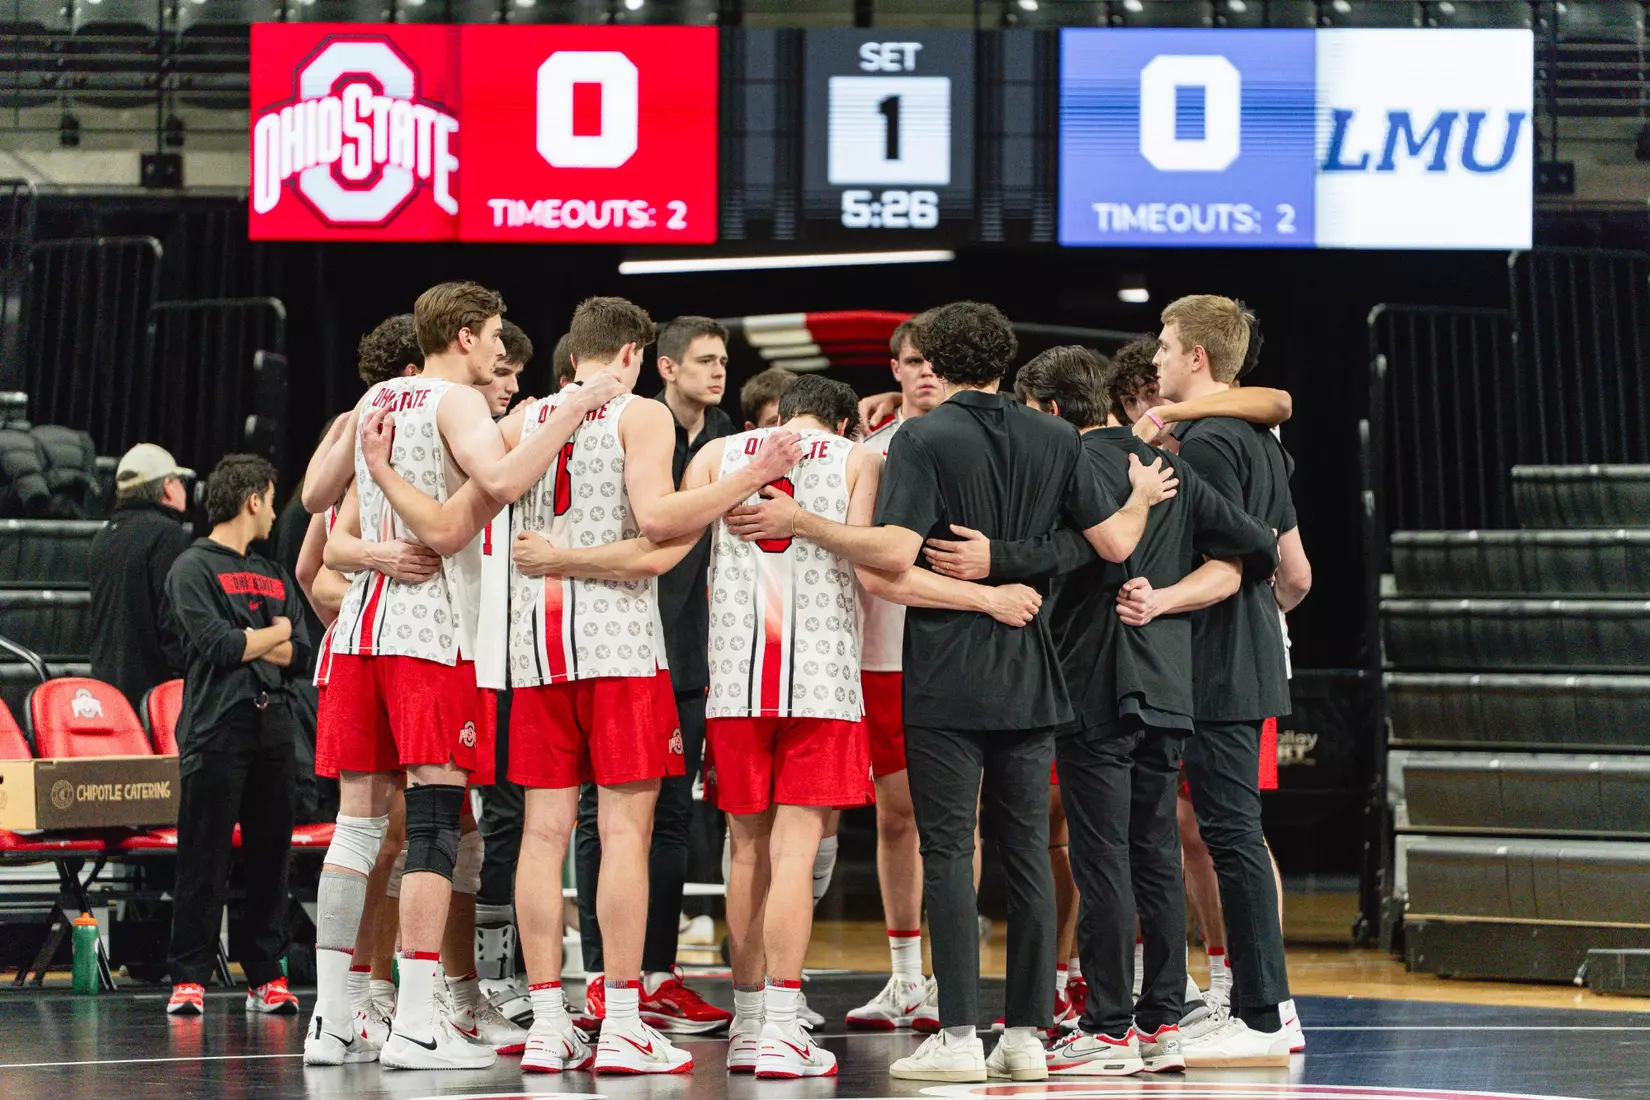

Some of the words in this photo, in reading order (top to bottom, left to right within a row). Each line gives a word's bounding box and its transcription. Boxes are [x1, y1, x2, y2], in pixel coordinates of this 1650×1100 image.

[859, 42, 923, 72] SET
[877, 94, 900, 160] 1
[1321, 108, 1526, 173] LMU
[253, 95, 342, 215] OHIO
[341, 83, 459, 215] STATE
[487, 199, 657, 229] TIMEOUTS:
[666, 200, 688, 230] 2
[841, 190, 939, 229] 5:26
[1091, 202, 1262, 234] TIMEOUTS:
[1275, 203, 1297, 234] 2
[76, 784, 122, 801] CHIPOTLE
[124, 780, 171, 800] CATERING
